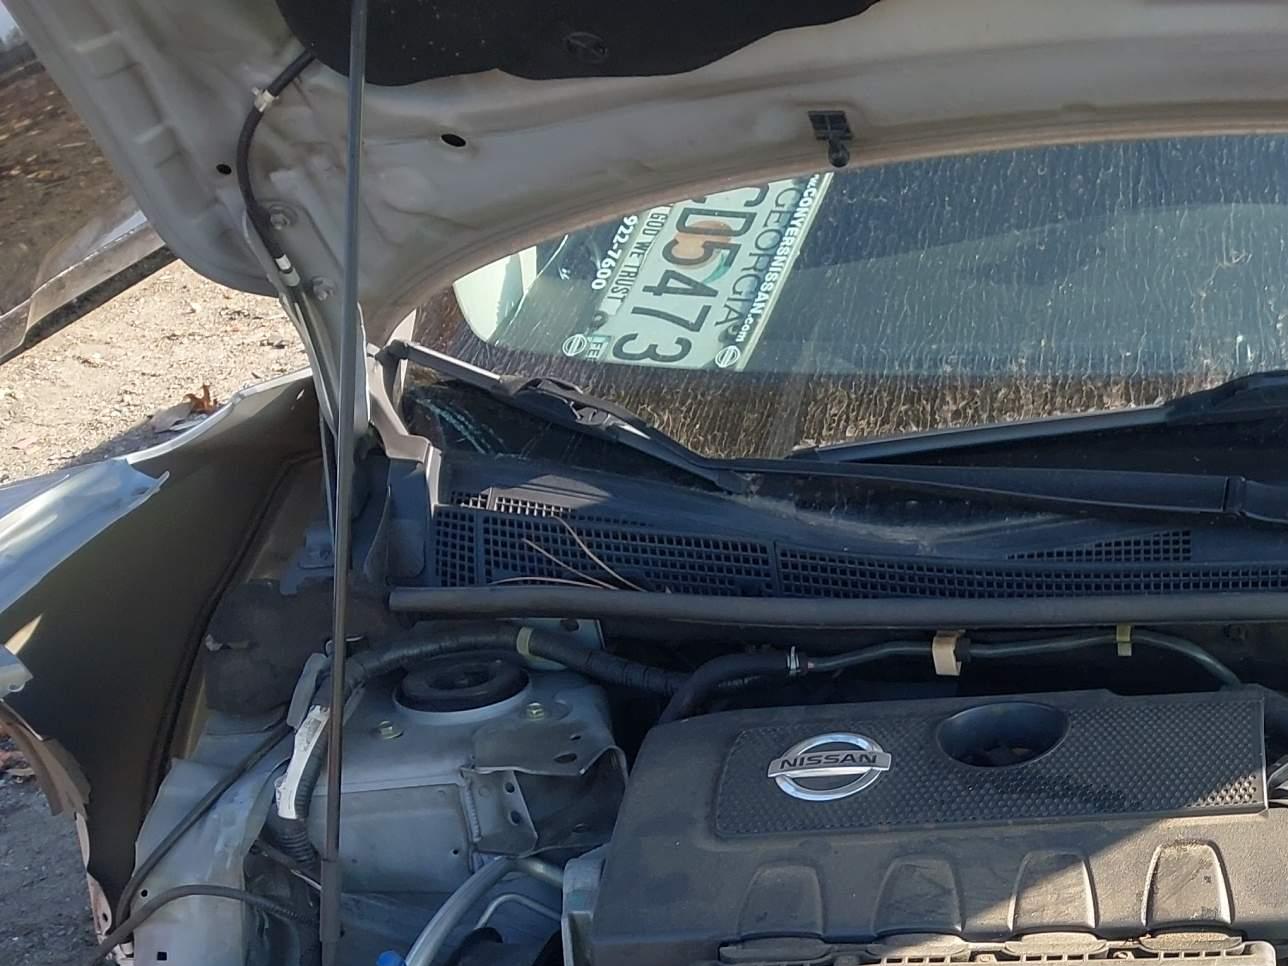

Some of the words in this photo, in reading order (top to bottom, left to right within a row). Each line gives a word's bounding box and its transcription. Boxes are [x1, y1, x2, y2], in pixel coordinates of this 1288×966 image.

[642, 212, 668, 237] GOD
[591, 215, 638, 290] 922-7600
[629, 241, 651, 261] WE
[714, 187, 801, 327] GEORGIA
[606, 264, 640, 302] TRUST
[780, 754, 877, 770] NISSAN
